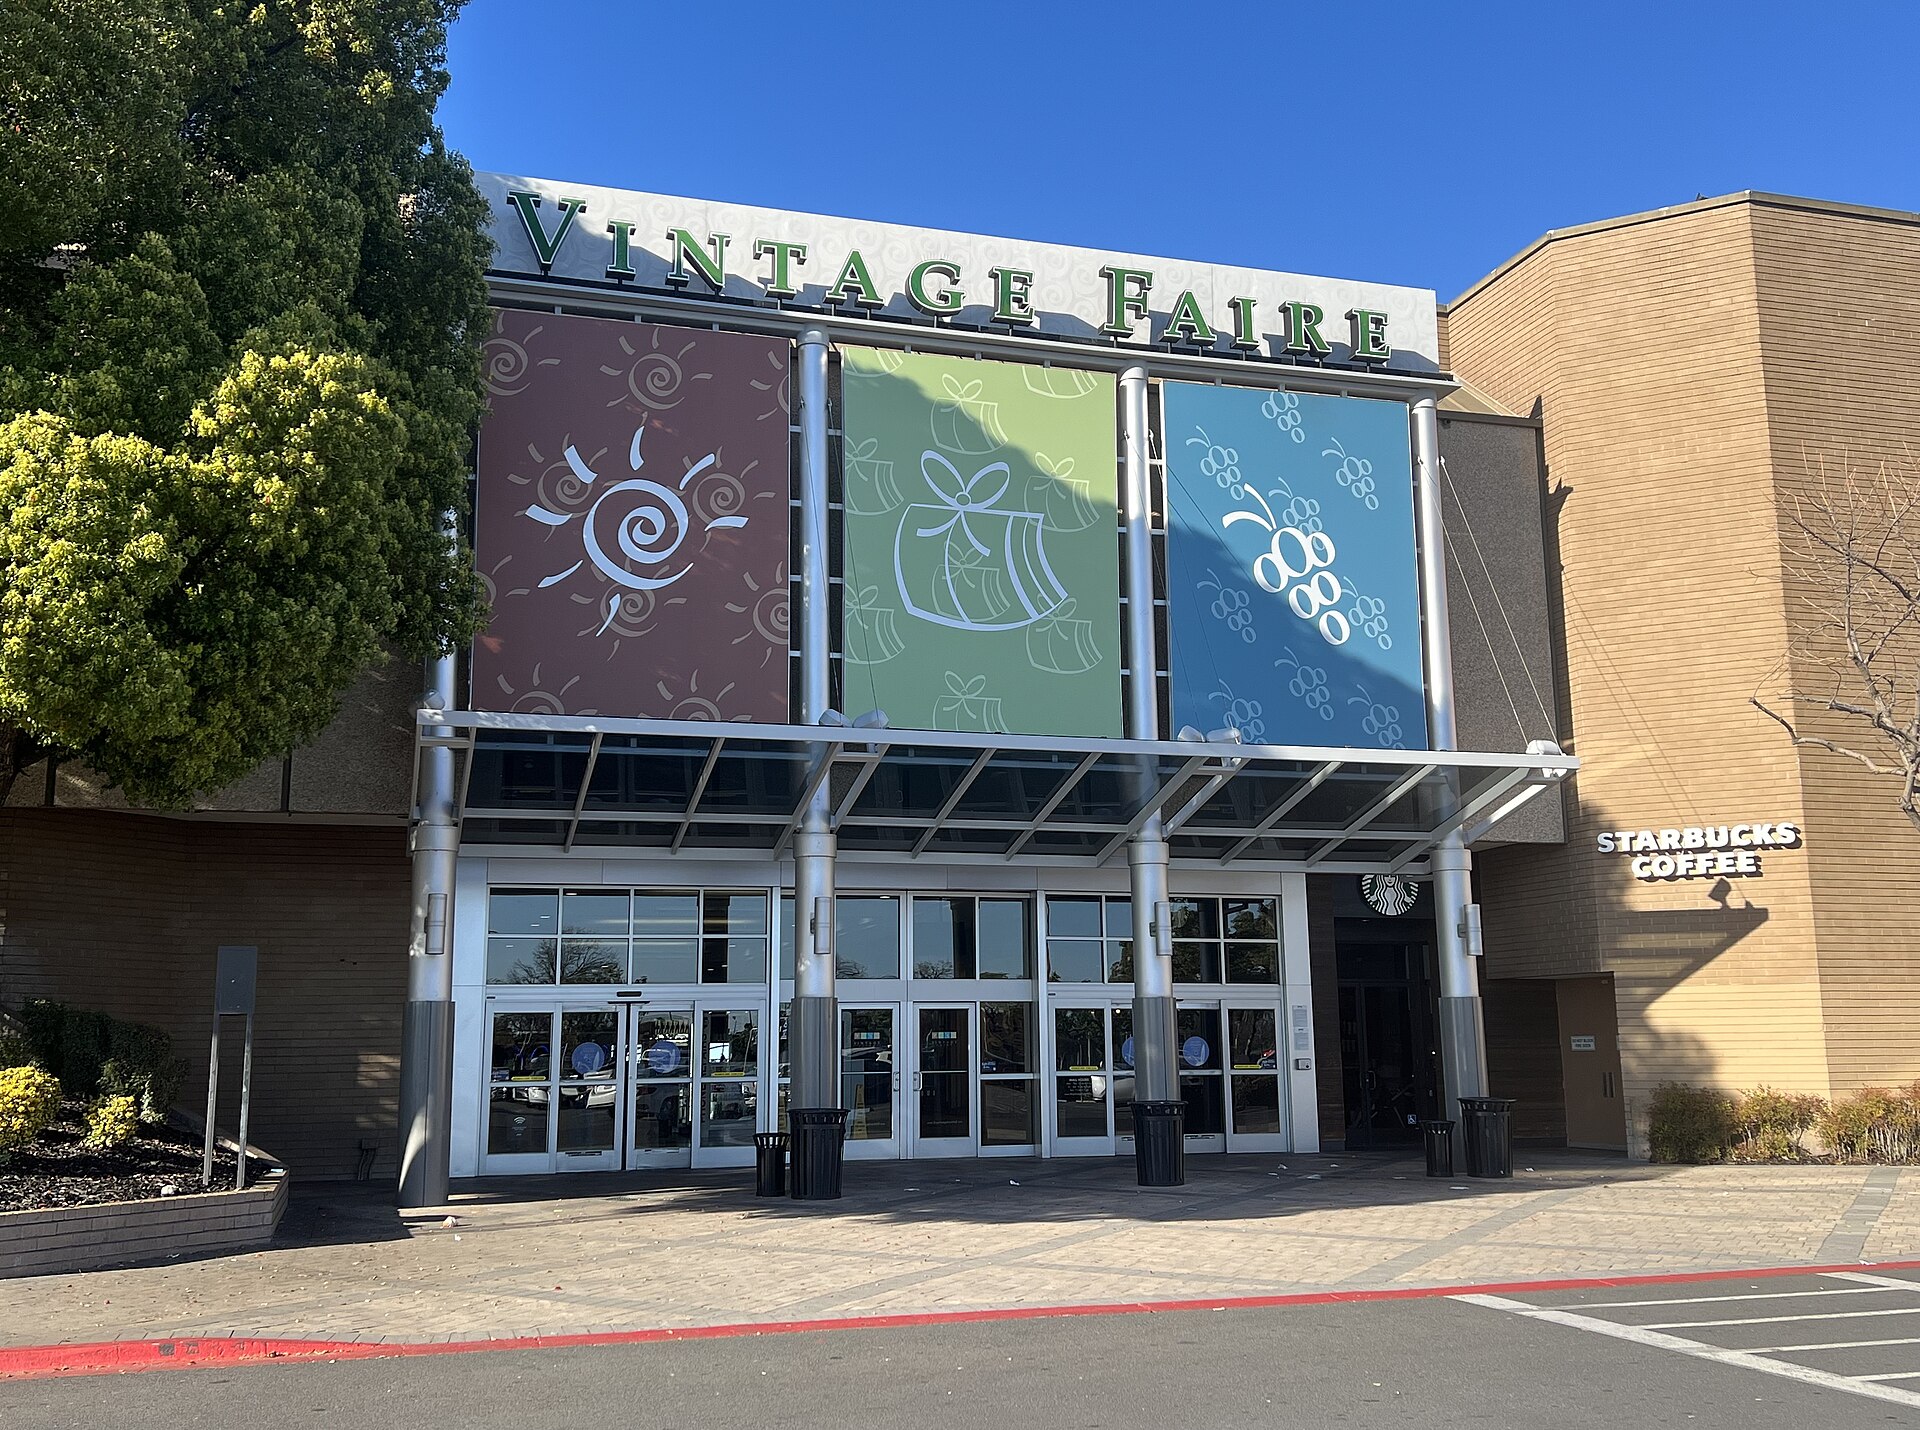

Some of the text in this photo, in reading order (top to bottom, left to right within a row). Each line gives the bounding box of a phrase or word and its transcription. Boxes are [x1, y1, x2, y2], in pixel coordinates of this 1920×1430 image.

[507, 190, 1392, 362] VINTAGE FAIRE
[1596, 822, 1798, 853] STARBUCKS
[1631, 851, 1758, 878] COFFEE
